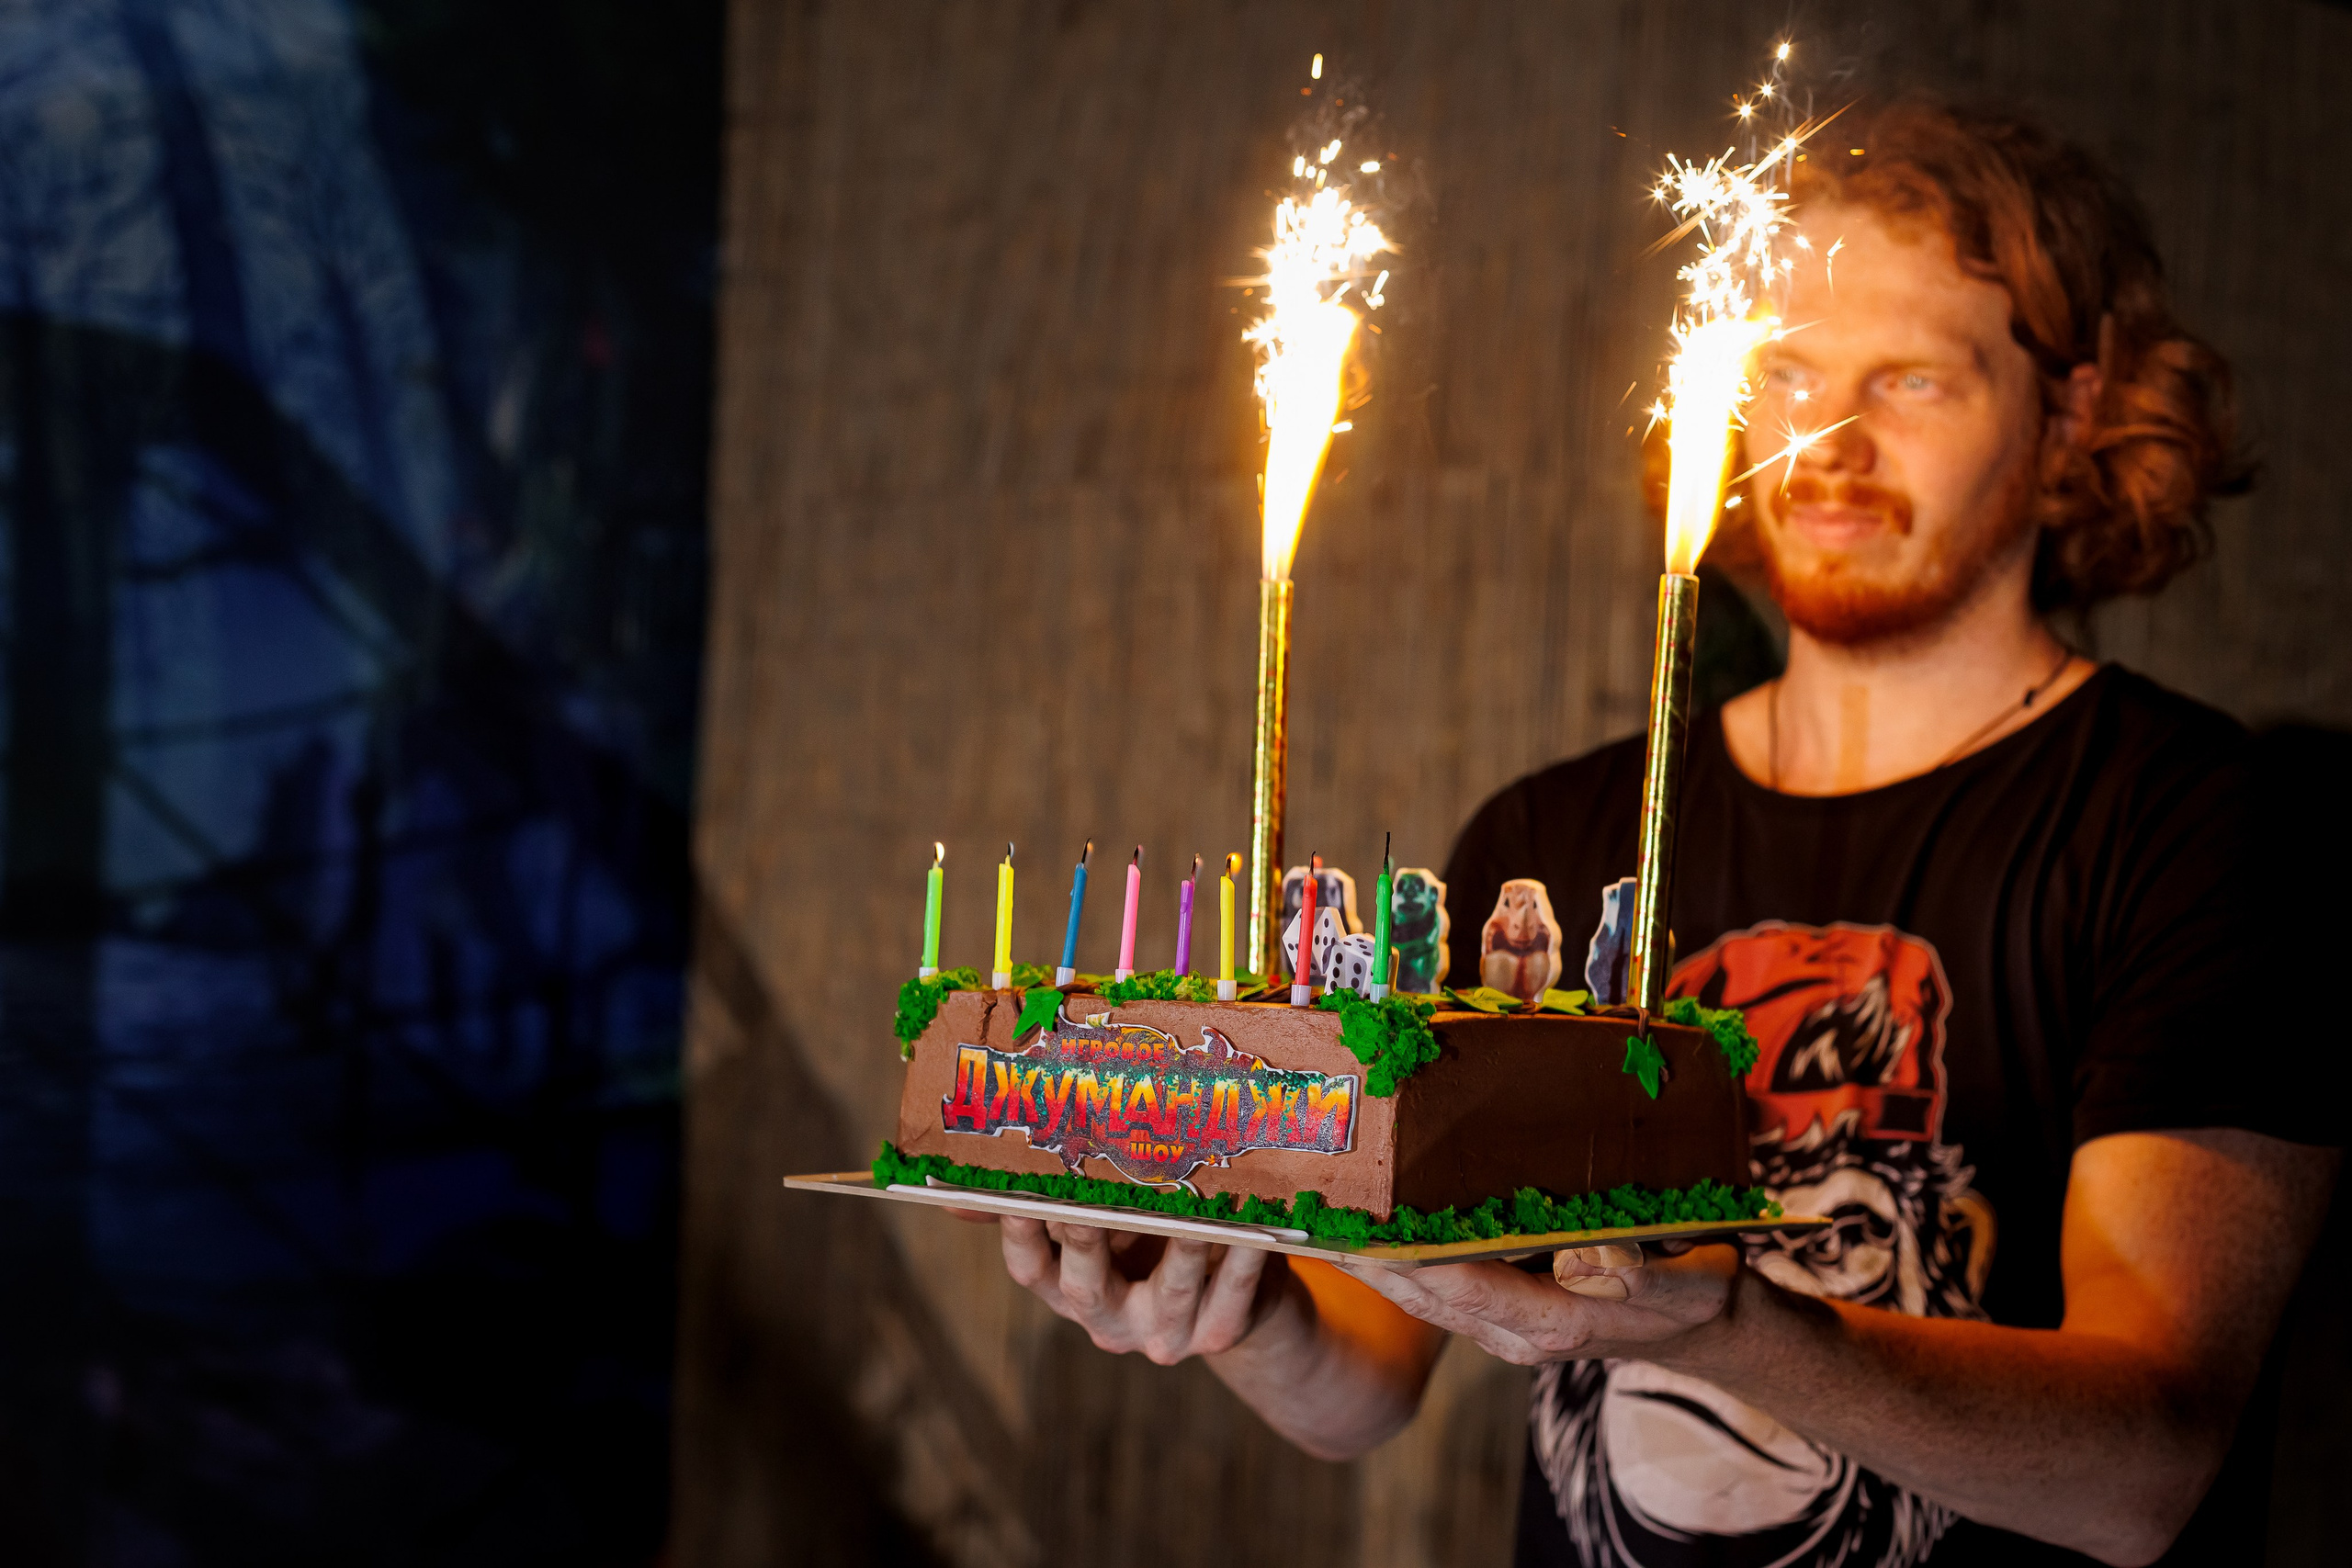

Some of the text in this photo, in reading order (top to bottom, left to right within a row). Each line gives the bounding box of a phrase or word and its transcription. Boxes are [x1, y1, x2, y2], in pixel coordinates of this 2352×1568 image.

[1061, 1038, 1165, 1061] ИГРОВОЕ
[944, 1047, 1352, 1151] ДЖУМАНДЖИ
[1130, 1142, 1184, 1164] ШОУ
